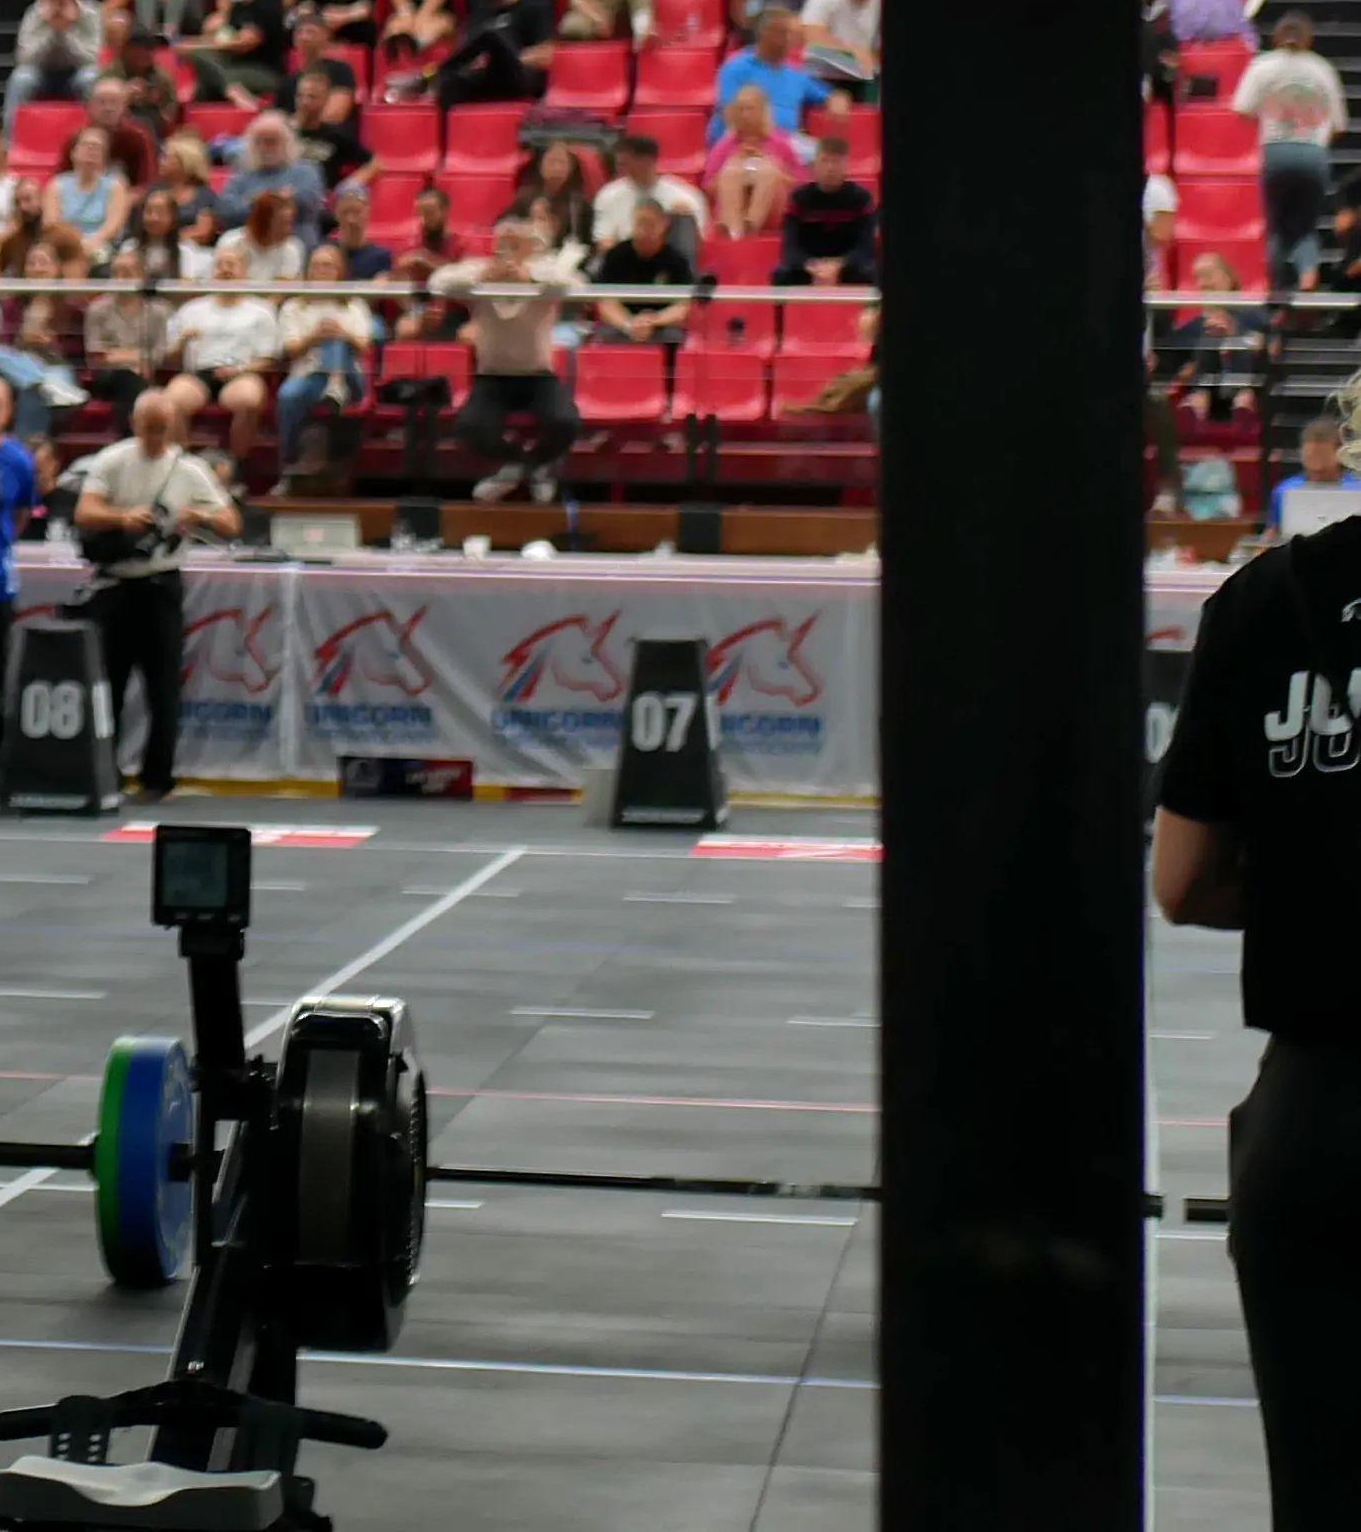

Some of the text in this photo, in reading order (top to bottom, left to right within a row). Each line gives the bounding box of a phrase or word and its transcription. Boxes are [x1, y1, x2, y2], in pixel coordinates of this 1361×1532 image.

[20, 680, 85, 740] 08
[631, 691, 698, 752] 07
[1145, 702, 1179, 764] 0
